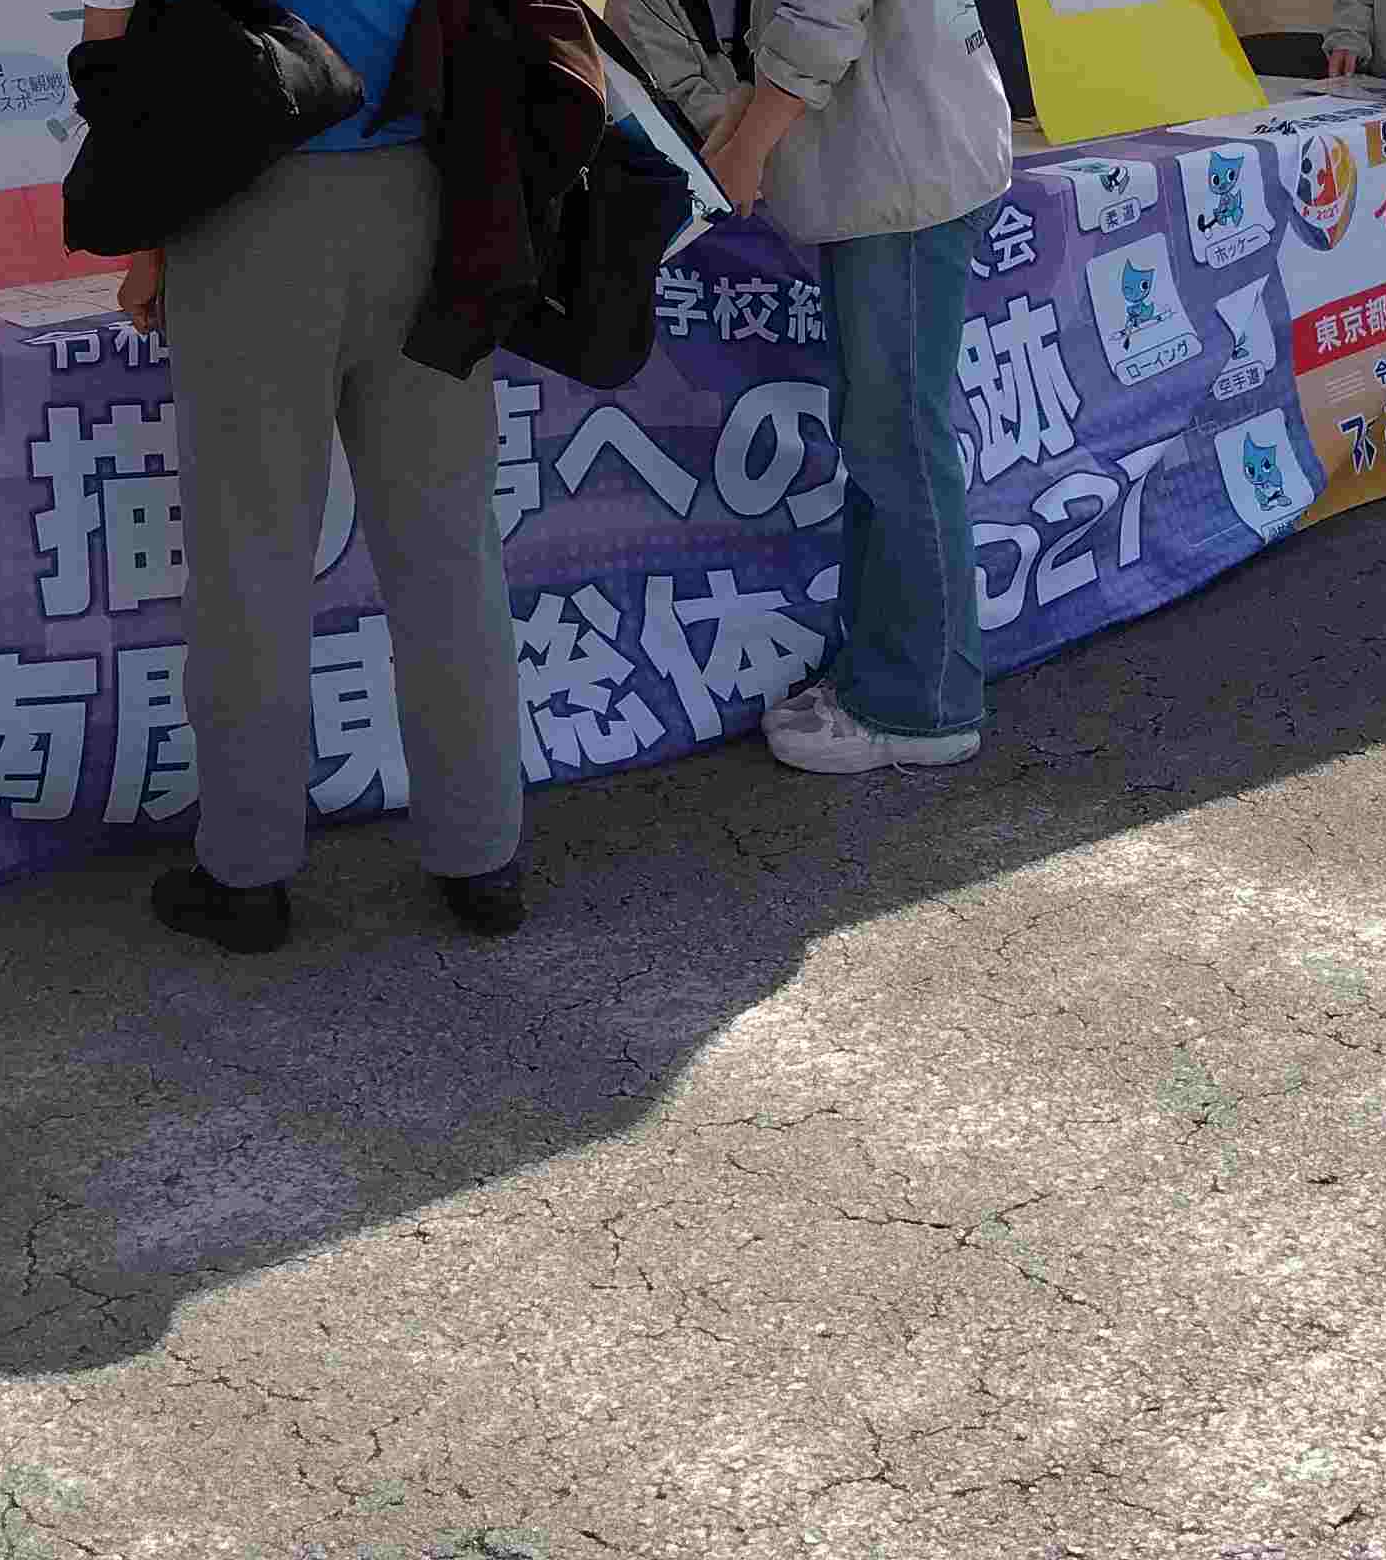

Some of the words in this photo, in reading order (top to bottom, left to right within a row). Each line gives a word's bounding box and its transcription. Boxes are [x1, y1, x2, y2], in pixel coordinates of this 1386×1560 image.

[1214, 236, 1260, 265] ホッケー
[1124, 340, 1189, 378] ローイング
